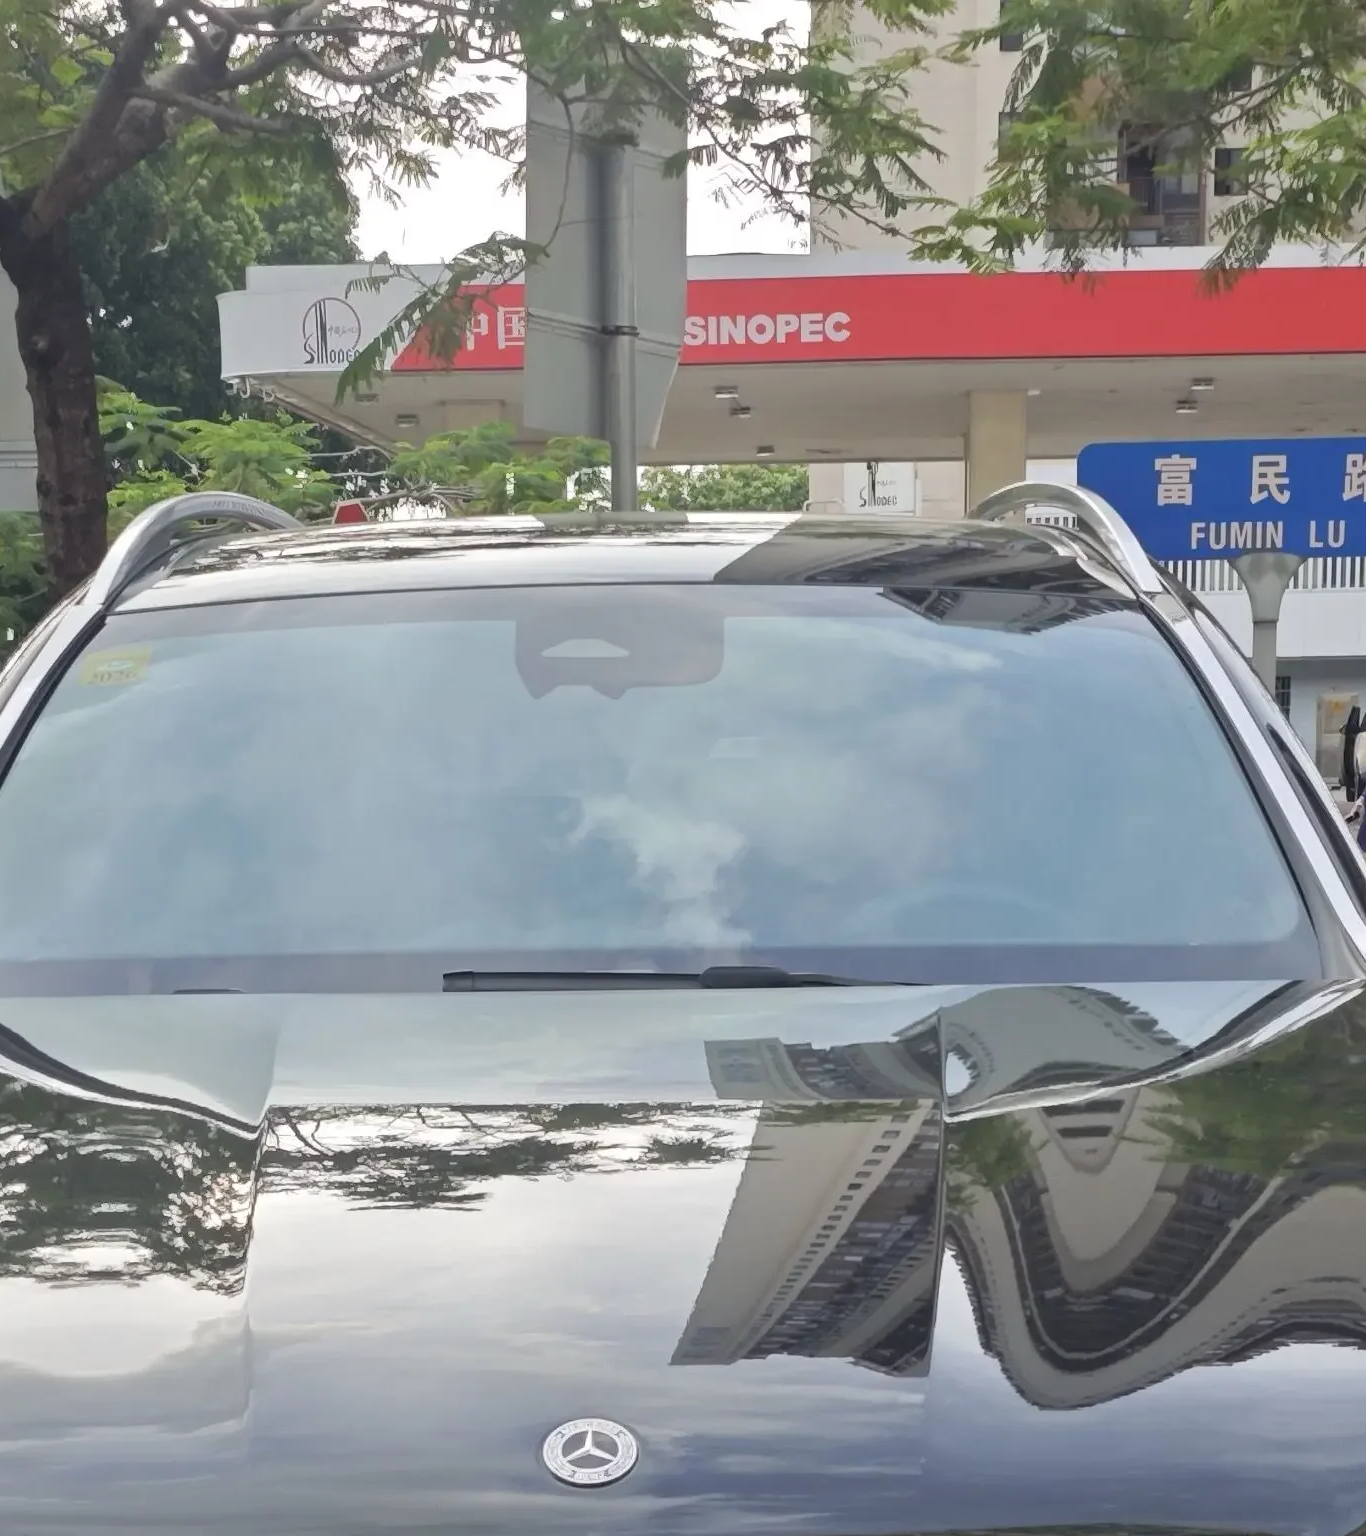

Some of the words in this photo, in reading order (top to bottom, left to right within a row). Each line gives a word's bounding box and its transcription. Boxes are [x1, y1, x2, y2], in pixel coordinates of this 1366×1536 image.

[683, 312, 851, 346] SINOPEC
[1191, 520, 1284, 550] FUMIN
[1309, 519, 1346, 548] LU
